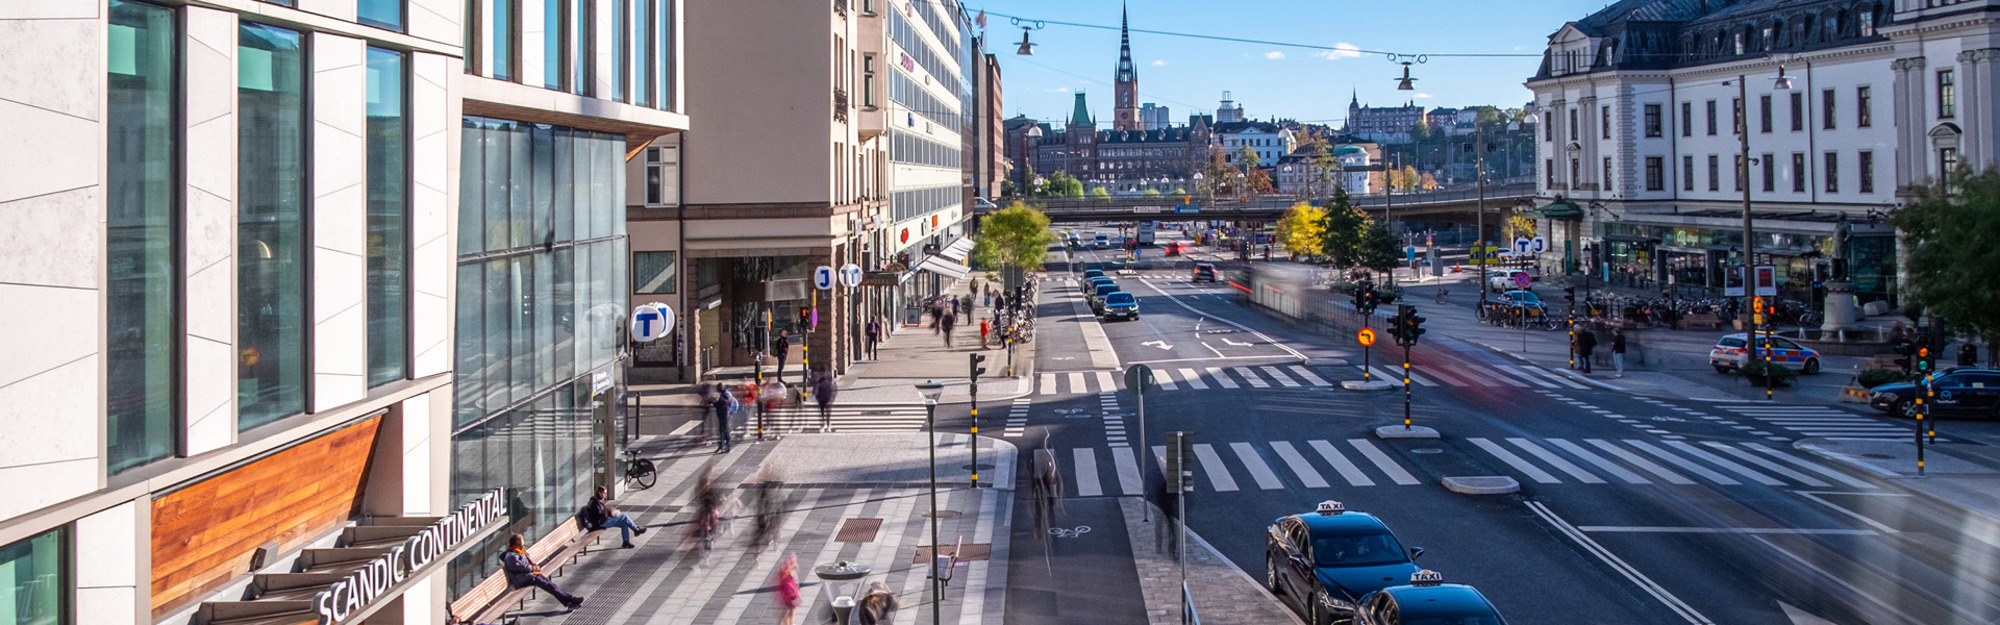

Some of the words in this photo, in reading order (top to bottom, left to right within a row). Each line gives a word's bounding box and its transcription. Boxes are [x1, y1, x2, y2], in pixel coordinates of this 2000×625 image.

[1518, 241, 1529, 253] T
[1534, 238, 1543, 252] J
[819, 269, 830, 288] J
[849, 268, 859, 285] T
[636, 312, 658, 337] T
[318, 546, 404, 625] SCANDIC
[407, 486, 507, 573] CONTINENTAL
